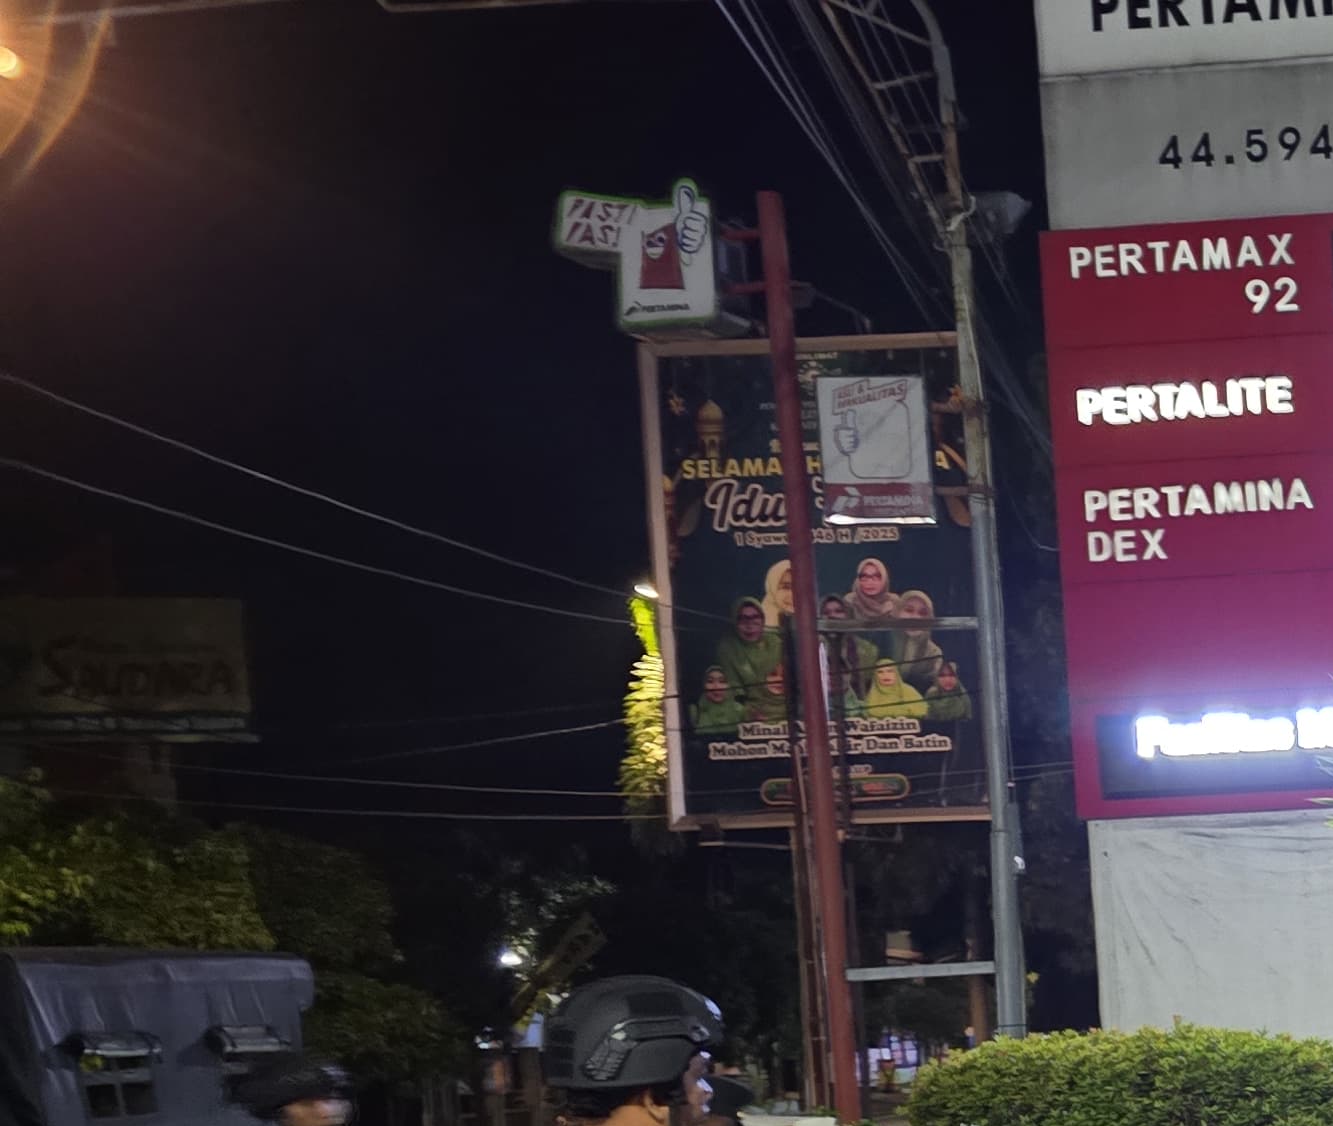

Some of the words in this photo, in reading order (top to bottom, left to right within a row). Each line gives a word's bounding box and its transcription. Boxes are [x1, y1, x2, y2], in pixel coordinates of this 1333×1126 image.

[1068, 233, 1296, 279] PERTAMAX
[1245, 276, 1299, 314] 92
[1076, 375, 1294, 426] PERTALITE
[681, 456, 784, 480] SELAMA
[1084, 477, 1314, 523] PERTAMINA
[863, 527, 898, 540] 2025
[1087, 528, 1168, 562] DEX
[742, 726, 788, 738] Minal
[865, 738, 895, 751] Dan
[903, 735, 949, 750] Batin
